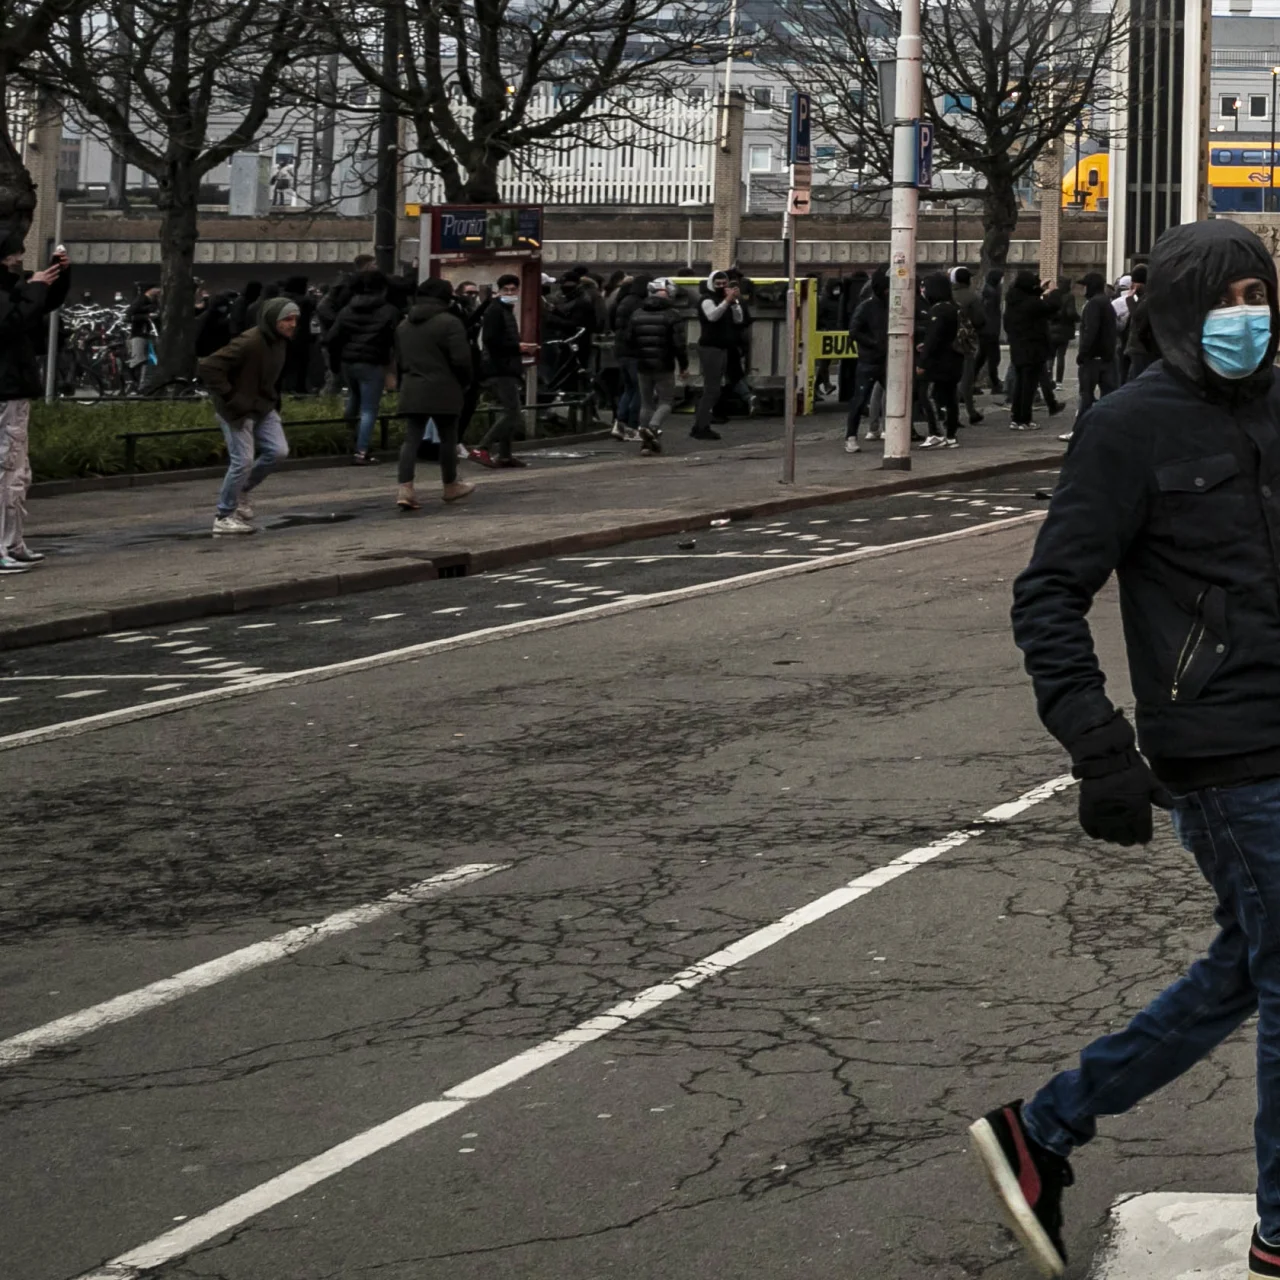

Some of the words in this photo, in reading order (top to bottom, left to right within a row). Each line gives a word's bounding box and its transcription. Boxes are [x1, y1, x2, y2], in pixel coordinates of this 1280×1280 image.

[800, 97, 808, 132] P
[921, 127, 930, 159] P
[441, 214, 486, 236] Pronto
